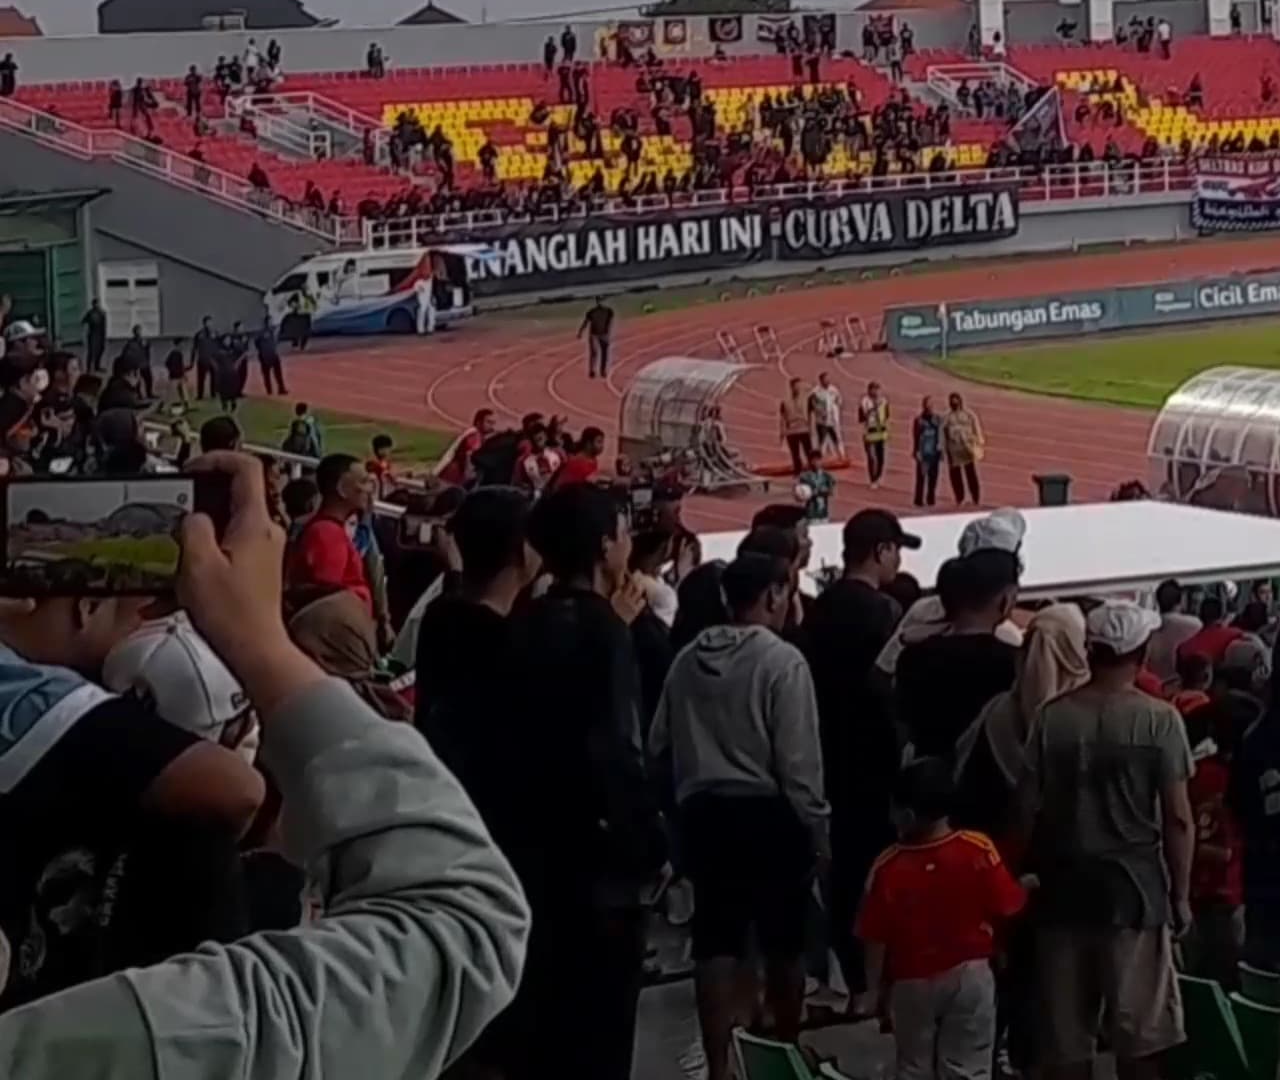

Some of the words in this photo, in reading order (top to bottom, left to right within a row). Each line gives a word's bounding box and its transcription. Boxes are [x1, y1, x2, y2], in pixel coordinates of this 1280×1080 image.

[637, 219, 711, 262] HARI
[720, 215, 763, 251] INI
[784, 202, 893, 249] CURVA
[906, 192, 1017, 239] DELTA
[952, 306, 1047, 332] Tabungan
[1049, 300, 1102, 322] Emas
[1200, 285, 1243, 309] Cicil
